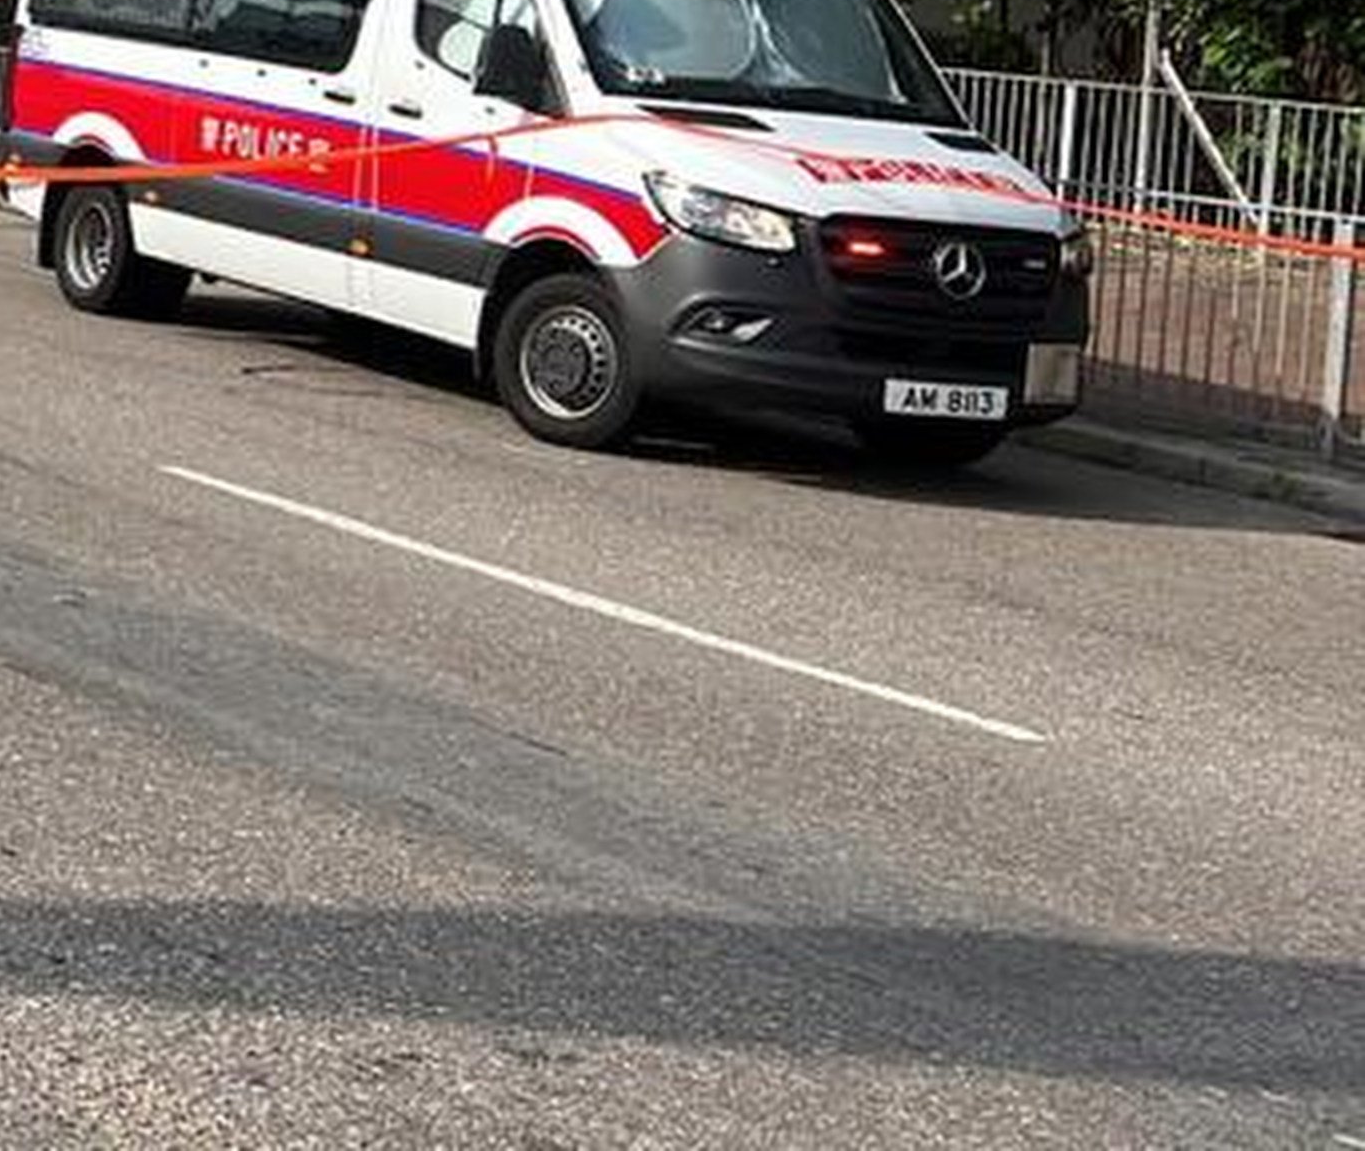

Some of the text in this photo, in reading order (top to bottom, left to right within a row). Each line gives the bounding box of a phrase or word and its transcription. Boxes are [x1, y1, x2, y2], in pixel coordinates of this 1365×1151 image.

[221, 119, 304, 161] POLICE
[903, 387, 994, 415] AM 8113
